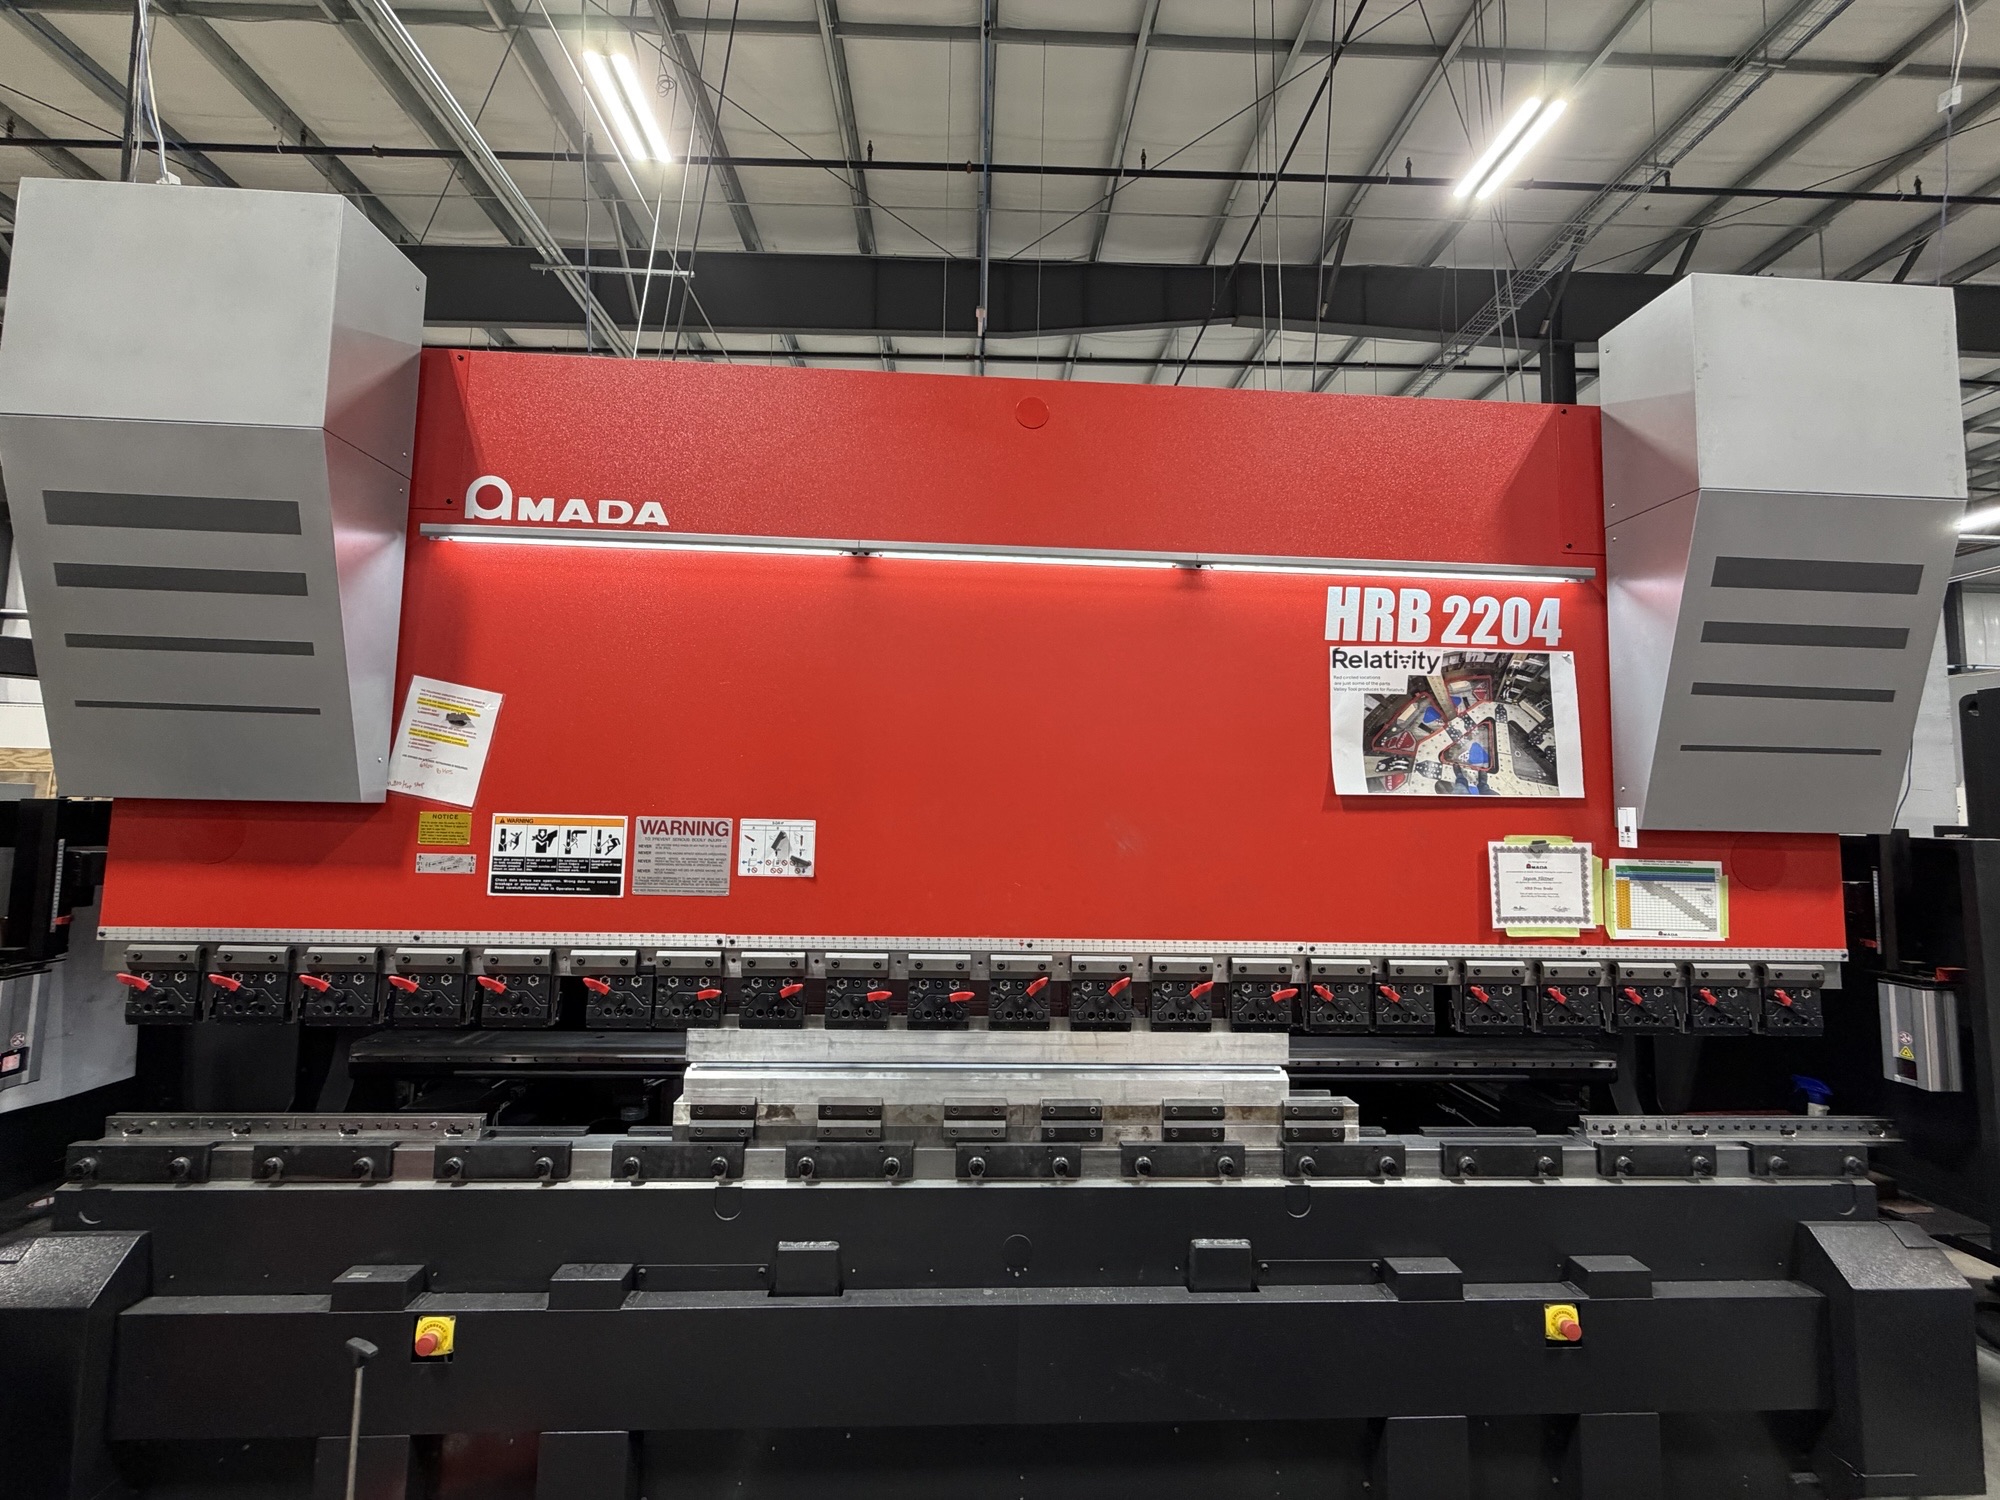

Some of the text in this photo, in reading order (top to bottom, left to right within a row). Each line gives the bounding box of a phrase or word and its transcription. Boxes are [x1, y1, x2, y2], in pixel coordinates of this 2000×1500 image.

[465, 475, 670, 526] AMADA
[1325, 586, 1562, 646] HRB 2204
[1332, 648, 1441, 674] Relativity
[640, 819, 729, 837] WARNING
